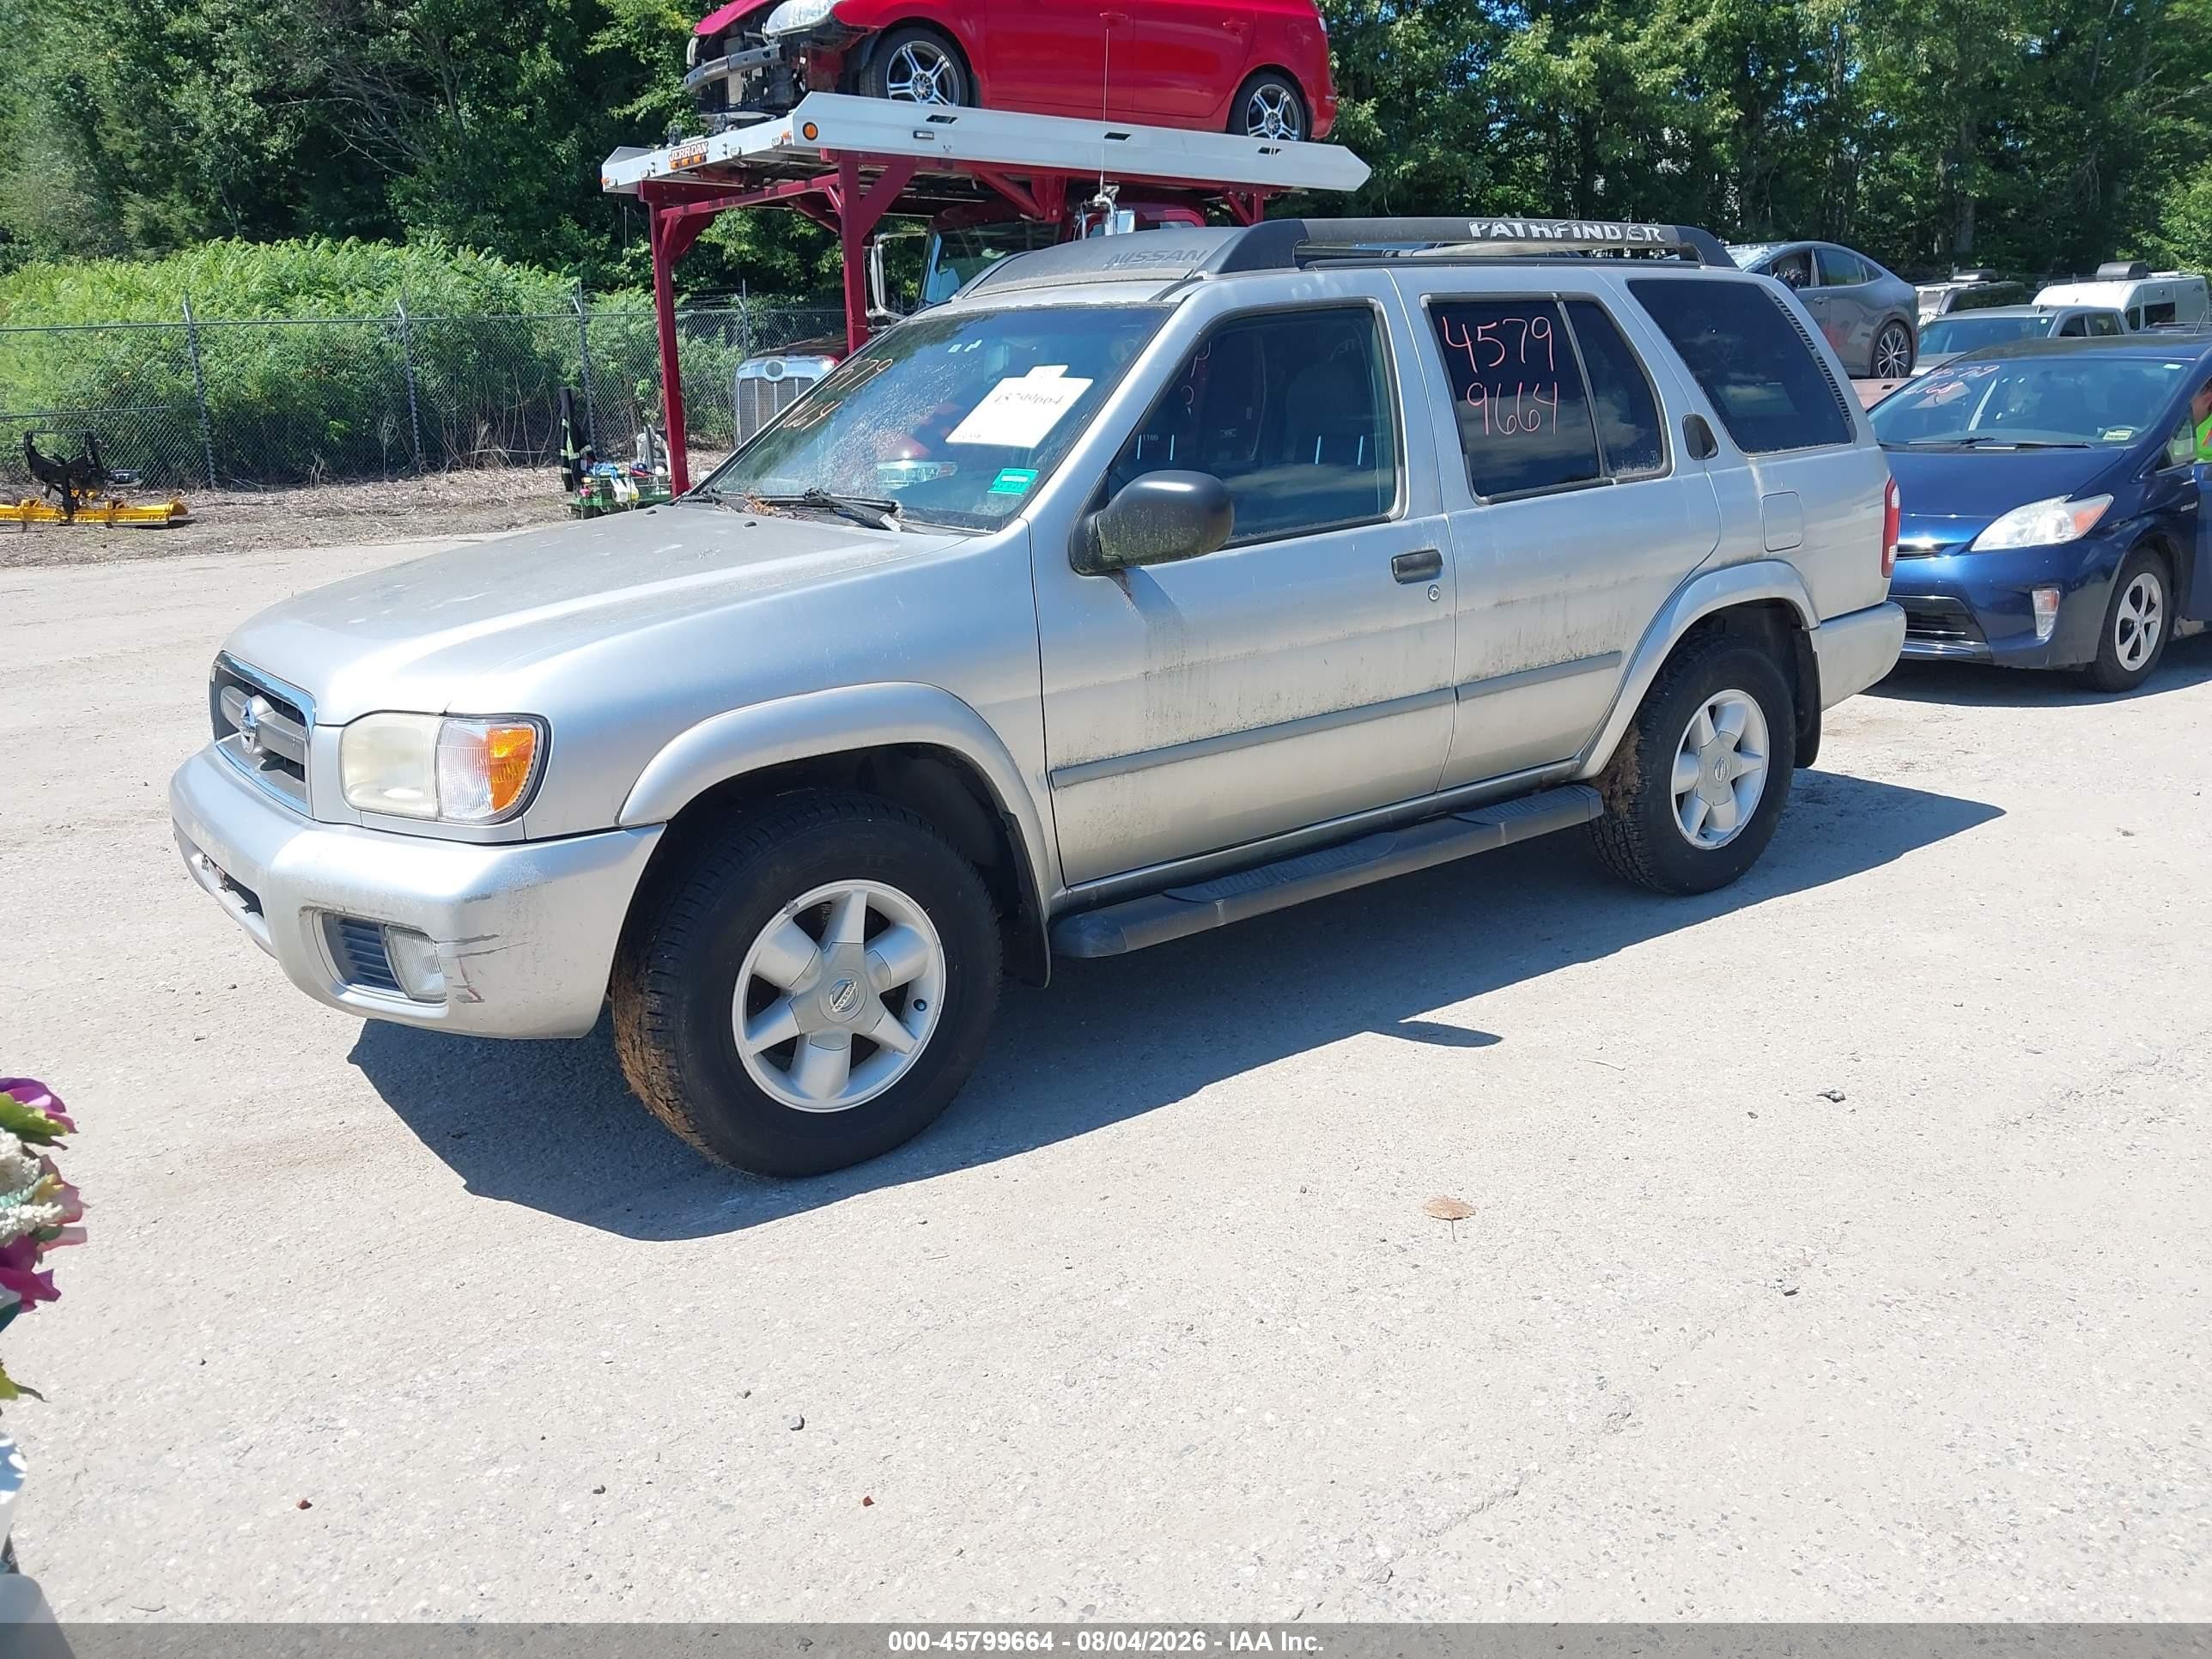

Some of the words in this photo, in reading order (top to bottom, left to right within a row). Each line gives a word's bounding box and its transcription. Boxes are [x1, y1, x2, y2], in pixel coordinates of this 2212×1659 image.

[1468, 221, 1666, 243] PATHFINDER
[1103, 249, 1207, 268] NISSAN
[1442, 315, 1555, 374] 4579
[1466, 381, 1559, 436] 9664
[834, 982, 855, 1011] NISSAN
